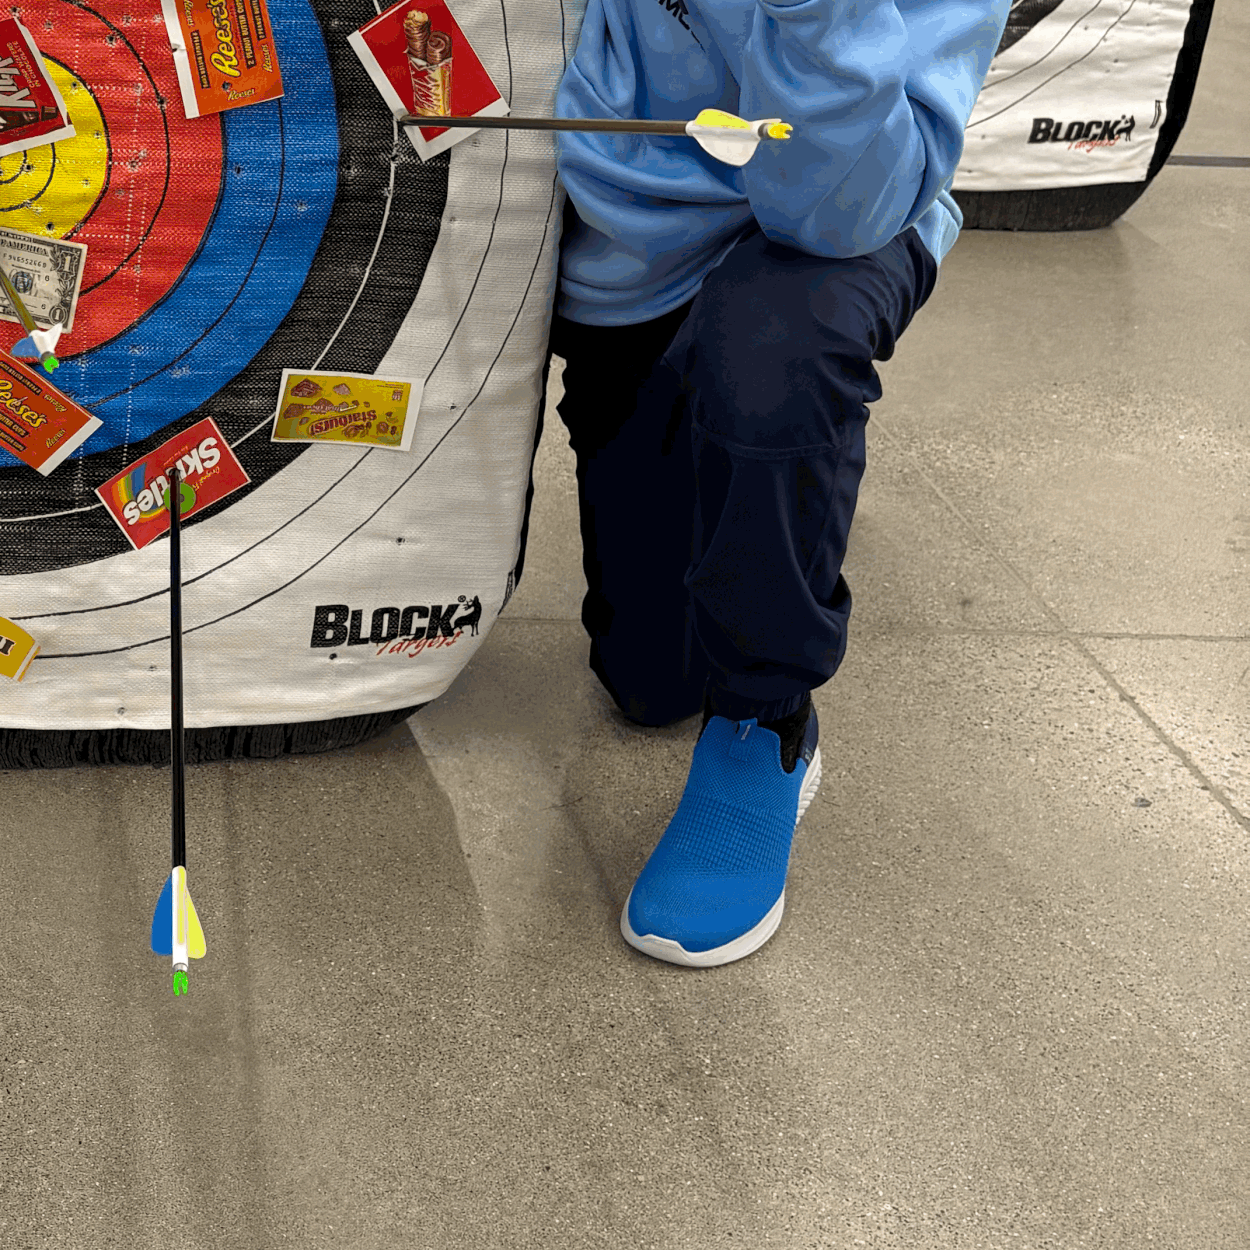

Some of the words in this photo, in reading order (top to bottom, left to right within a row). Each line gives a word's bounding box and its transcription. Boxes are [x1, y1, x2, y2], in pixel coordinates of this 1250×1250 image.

[1027, 118, 1121, 144] BLOCK
[310, 410, 377, 436] Starburst
[310, 605, 460, 648] BLOCK
